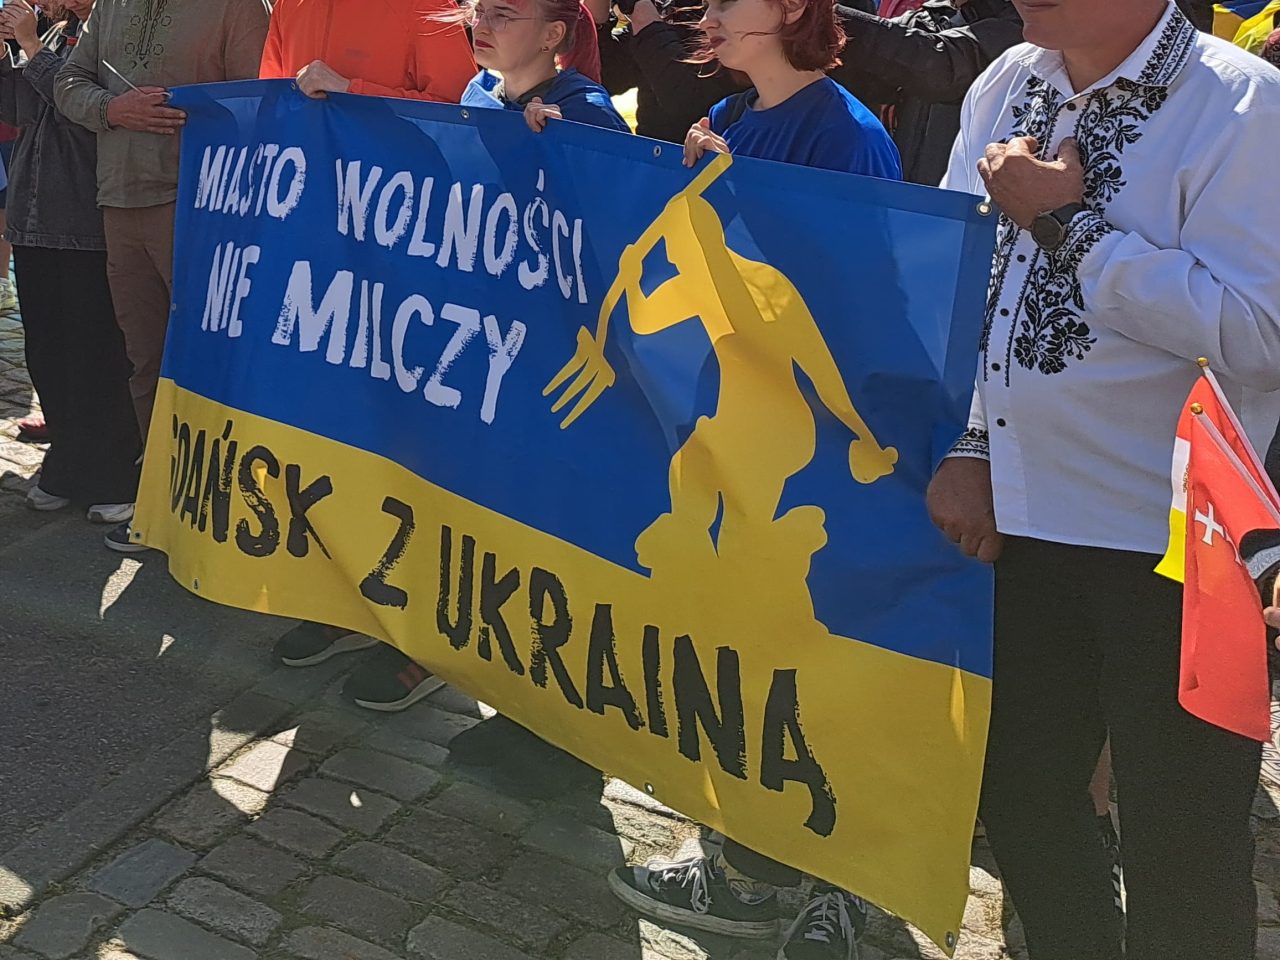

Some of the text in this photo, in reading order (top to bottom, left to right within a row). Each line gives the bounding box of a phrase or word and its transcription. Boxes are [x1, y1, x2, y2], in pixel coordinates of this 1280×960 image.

[194, 142, 588, 305] MIASTO WOLNOŚCI
[200, 241, 527, 426] NIE MILCZY
[170, 413, 838, 838] DAŃSK Z UKRAINĄ
